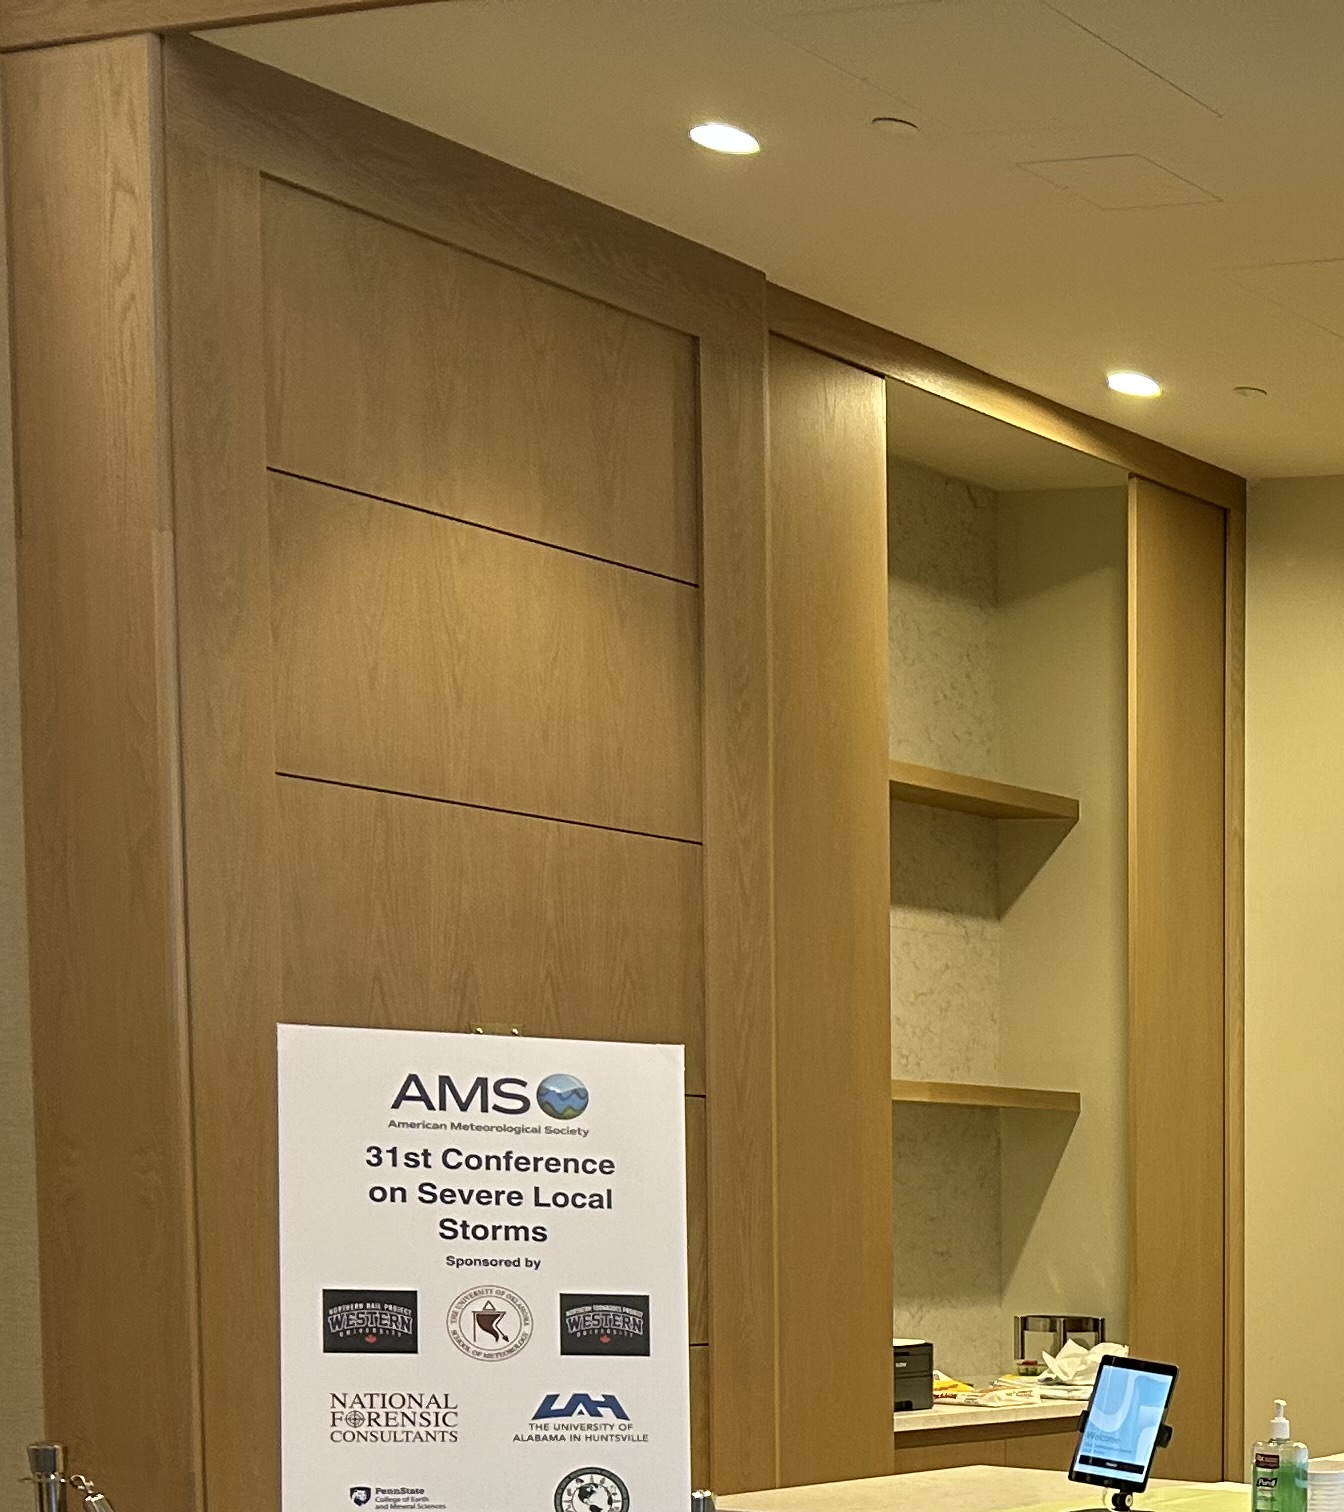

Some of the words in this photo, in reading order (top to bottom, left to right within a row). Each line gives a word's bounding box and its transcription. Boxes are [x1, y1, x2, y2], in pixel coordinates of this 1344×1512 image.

[390, 1072, 531, 1115] AMS
[388, 1120, 447, 1131] American
[450, 1121, 541, 1135] Meteorological
[545, 1126, 589, 1138] Society
[366, 1146, 432, 1169] 31st
[441, 1147, 616, 1175] Conference
[369, 1185, 407, 1203] on
[418, 1182, 524, 1207] Severe
[534, 1186, 612, 1210] Local
[439, 1217, 548, 1242] Storms
[446, 1255, 521, 1269] Sponsored
[525, 1257, 541, 1270] by
[328, 1310, 413, 1334] WESTERN
[566, 1312, 643, 1335] WESTERN
[330, 1392, 458, 1409] NATIONAL
[531, 1393, 630, 1421] UAH
[330, 1430, 458, 1443] CONSULTANTS
[529, 1423, 549, 1431] THE
[553, 1423, 615, 1431] UNIVERSITY
[618, 1423, 633, 1431] OF
[512, 1434, 566, 1442] ALABAMA
[569, 1434, 581, 1442] IN
[584, 1434, 649, 1442] HUNTSVILLE
[375, 1487, 425, 1495] PennState
